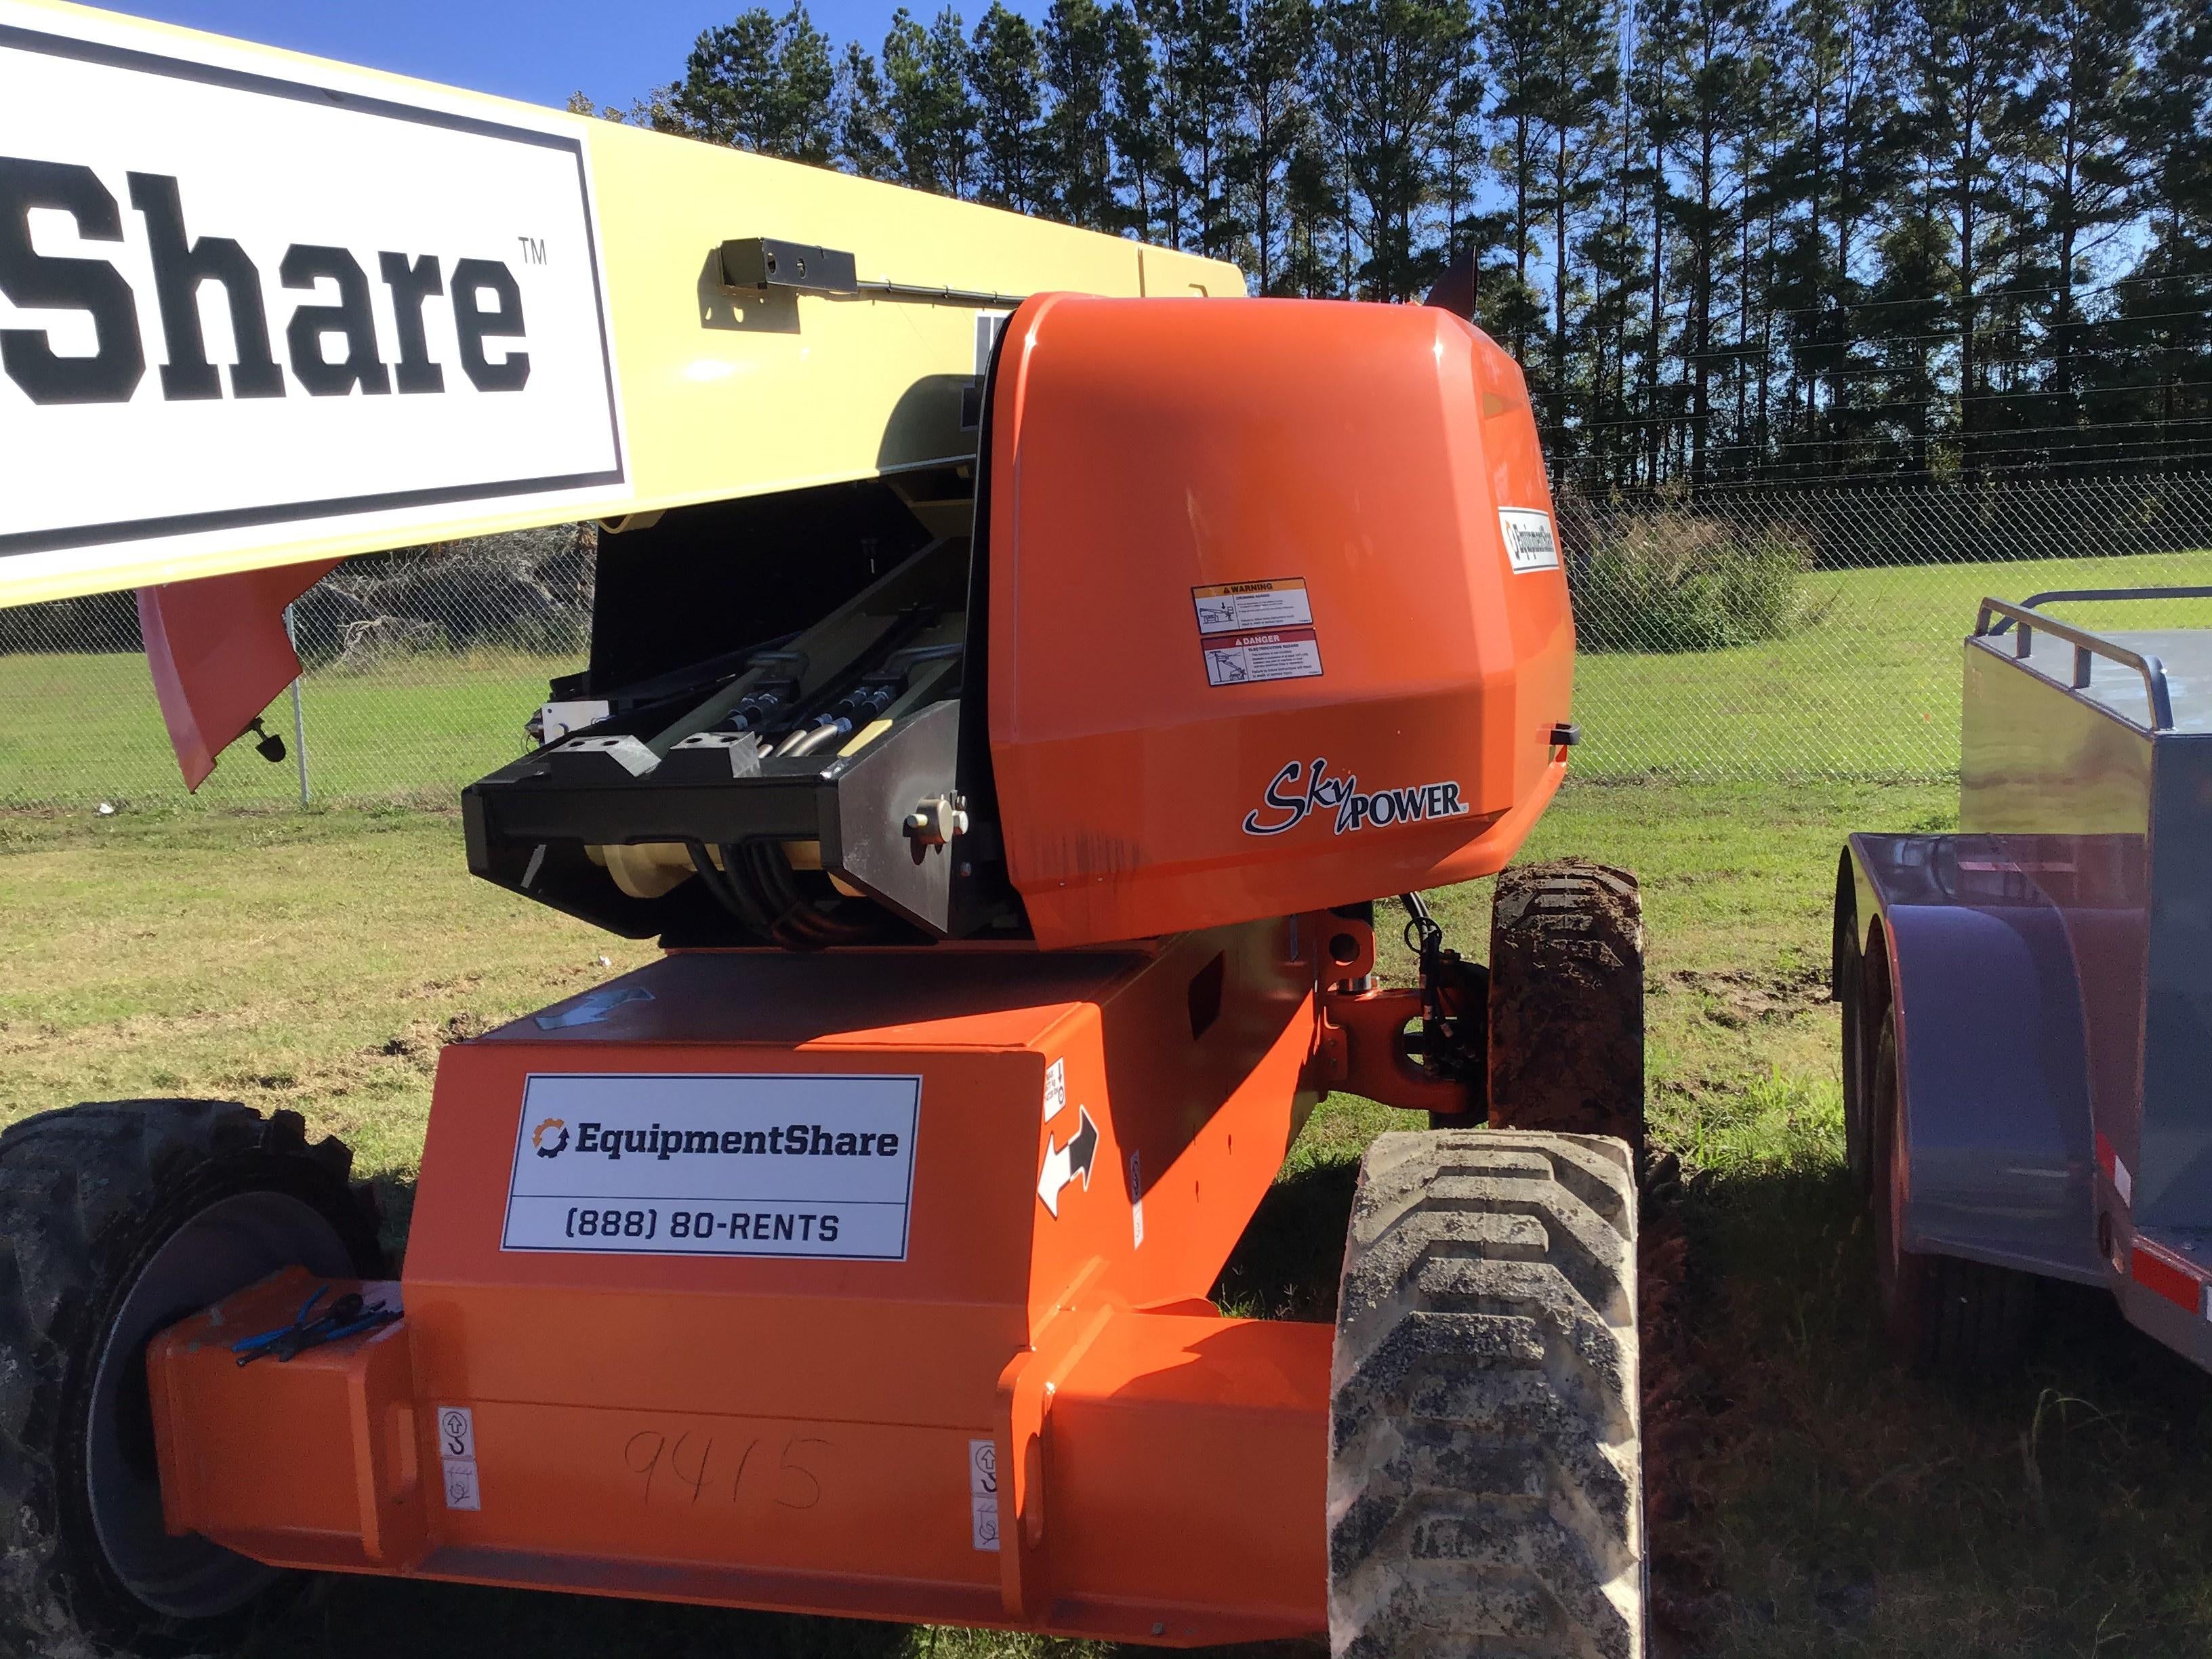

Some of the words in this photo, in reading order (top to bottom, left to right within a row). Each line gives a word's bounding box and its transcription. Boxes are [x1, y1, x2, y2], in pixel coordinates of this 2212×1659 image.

[0, 156, 531, 405] Share
[518, 237, 547, 266] TM
[1231, 583, 1273, 594] WARNING
[1243, 634, 1281, 645] DANGER
[575, 1122, 899, 1160] EquipmentShare
[566, 1207, 657, 1240] (888)
[670, 1212, 840, 1242] 80-RENTS
[624, 1431, 835, 1510] 9415
